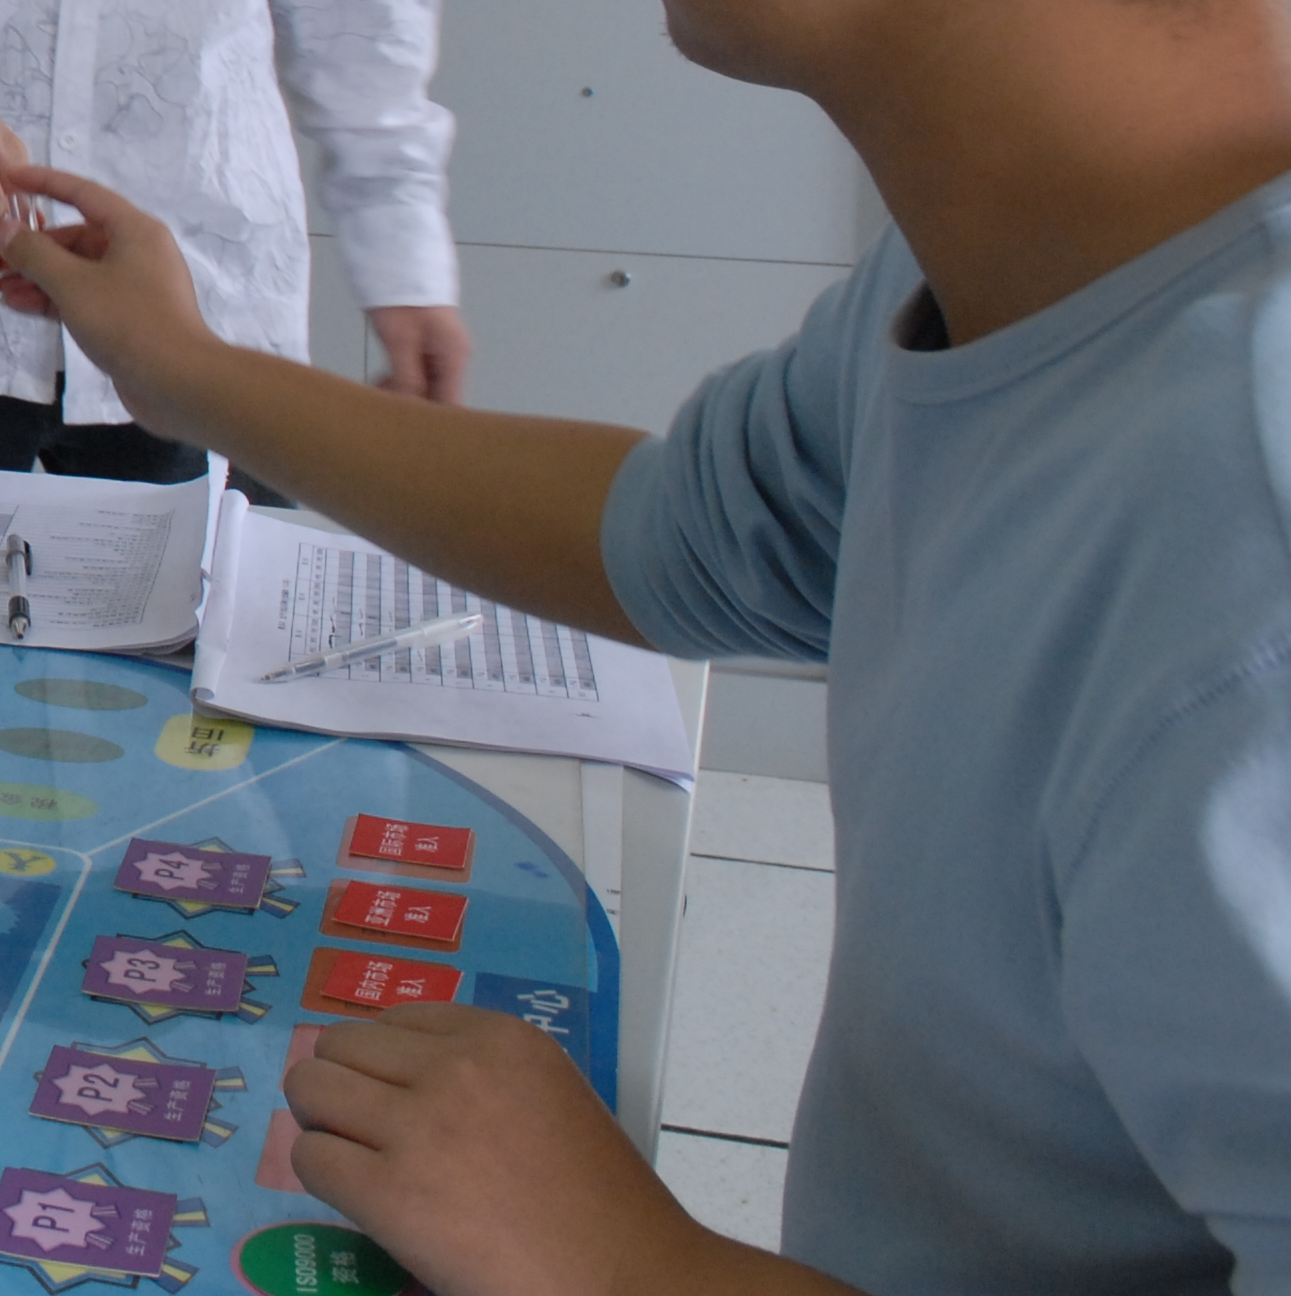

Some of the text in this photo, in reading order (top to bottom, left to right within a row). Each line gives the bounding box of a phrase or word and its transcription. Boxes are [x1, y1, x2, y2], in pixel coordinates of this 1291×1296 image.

[153, 857, 188, 880] P4
[123, 958, 160, 982] P3
[354, 960, 394, 1001] 国内市场
[76, 1073, 119, 1102] P2
[163, 1080, 191, 1122] 生产资格
[31, 1201, 76, 1231] P1
[125, 1208, 153, 1257] 生产资格
[293, 1234, 318, 1293] ISO9000
